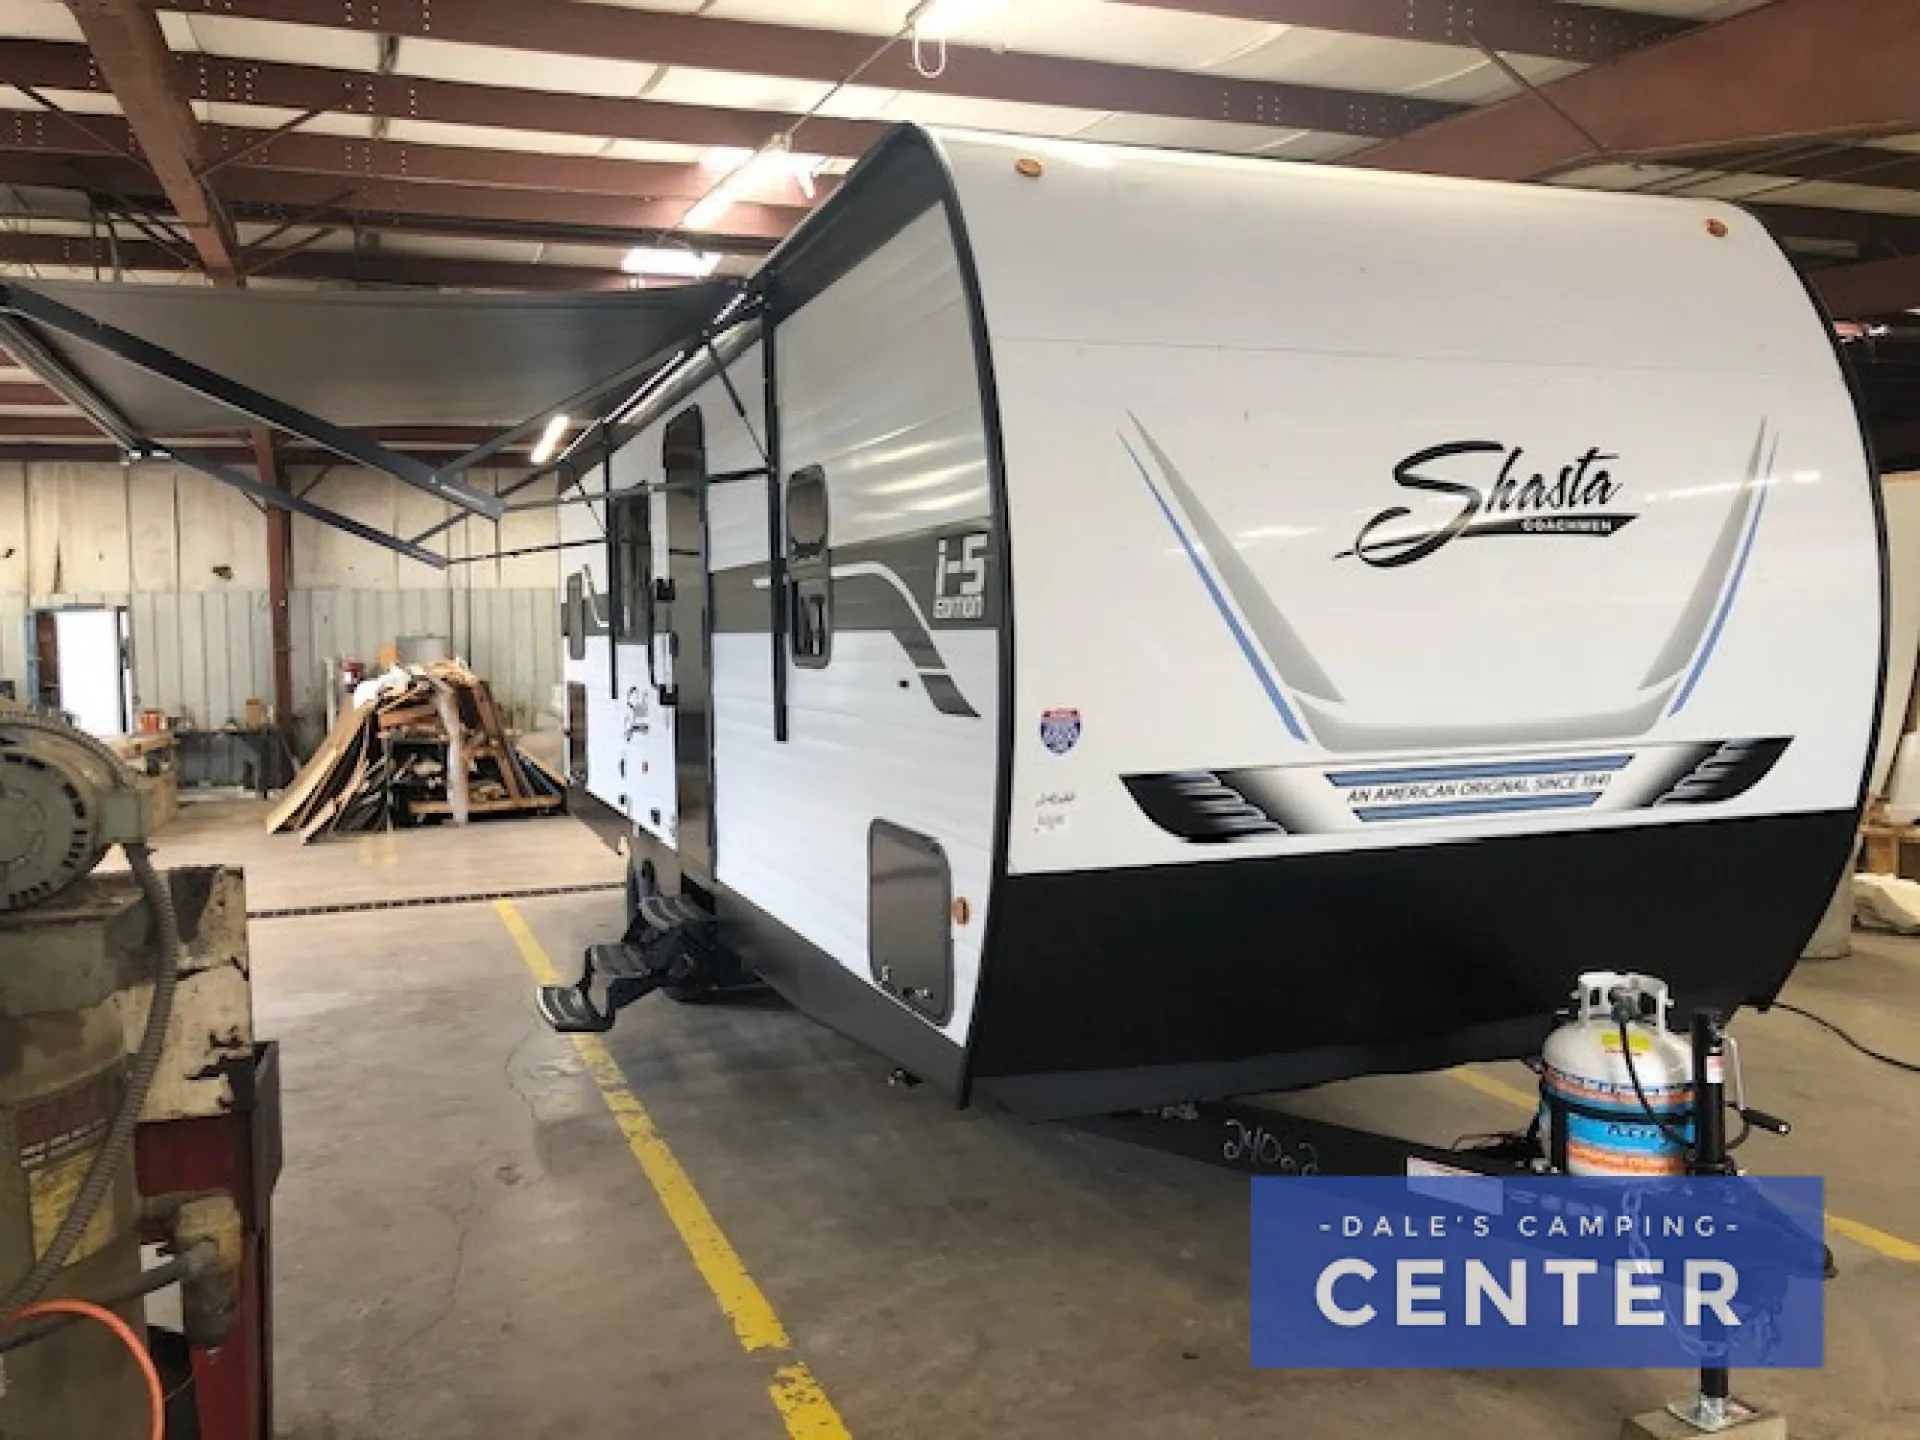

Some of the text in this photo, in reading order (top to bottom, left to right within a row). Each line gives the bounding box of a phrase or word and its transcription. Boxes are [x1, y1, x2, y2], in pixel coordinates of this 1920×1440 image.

[1354, 439, 1623, 568] Shasta
[1346, 787, 1370, 802] AN
[1373, 783, 1456, 801] AMERICAN
[1460, 778, 1529, 796] ORIGINAL
[1535, 775, 1578, 792] SINCE
